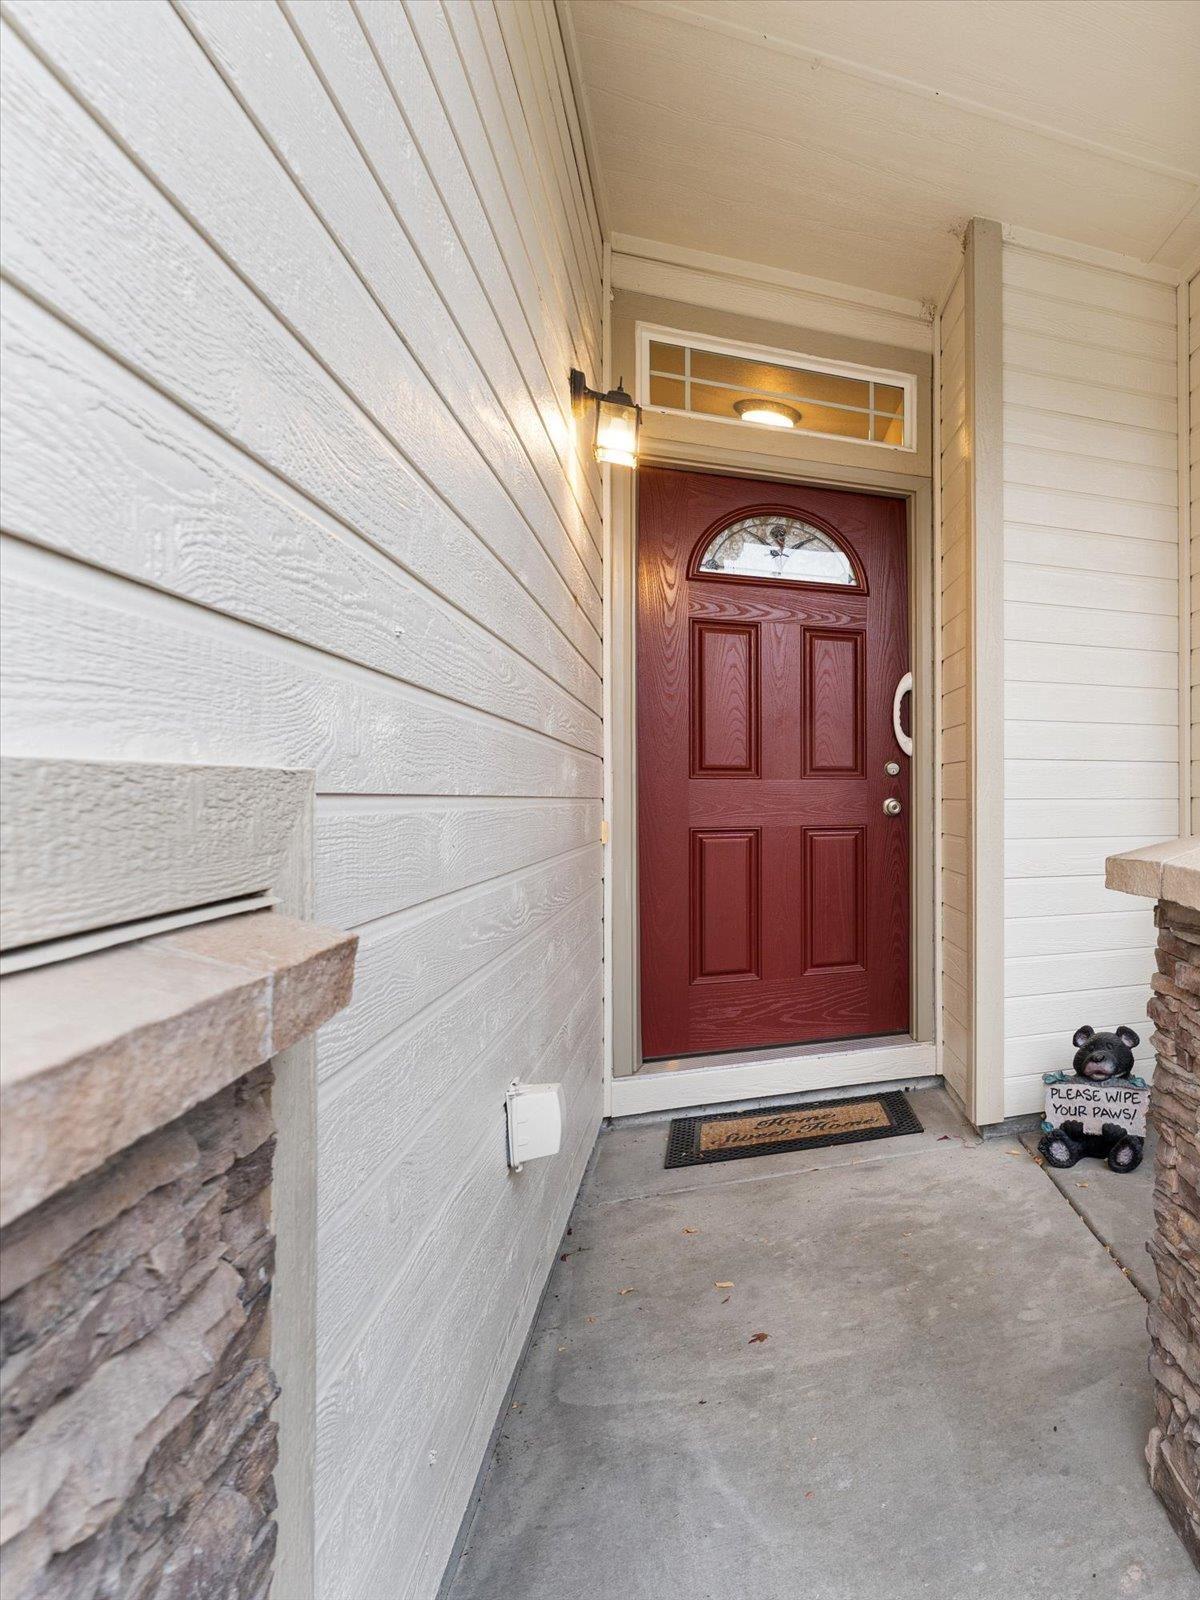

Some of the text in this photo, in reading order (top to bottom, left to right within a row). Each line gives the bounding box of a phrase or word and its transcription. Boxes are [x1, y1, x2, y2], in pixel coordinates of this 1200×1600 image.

[1050, 1088, 1141, 1104] PLEASE WIPE
[754, 1113, 836, 1130] Home
[1052, 1103, 1137, 1125] YOUR PAWS!
[711, 1117, 879, 1145] Sweet Home
